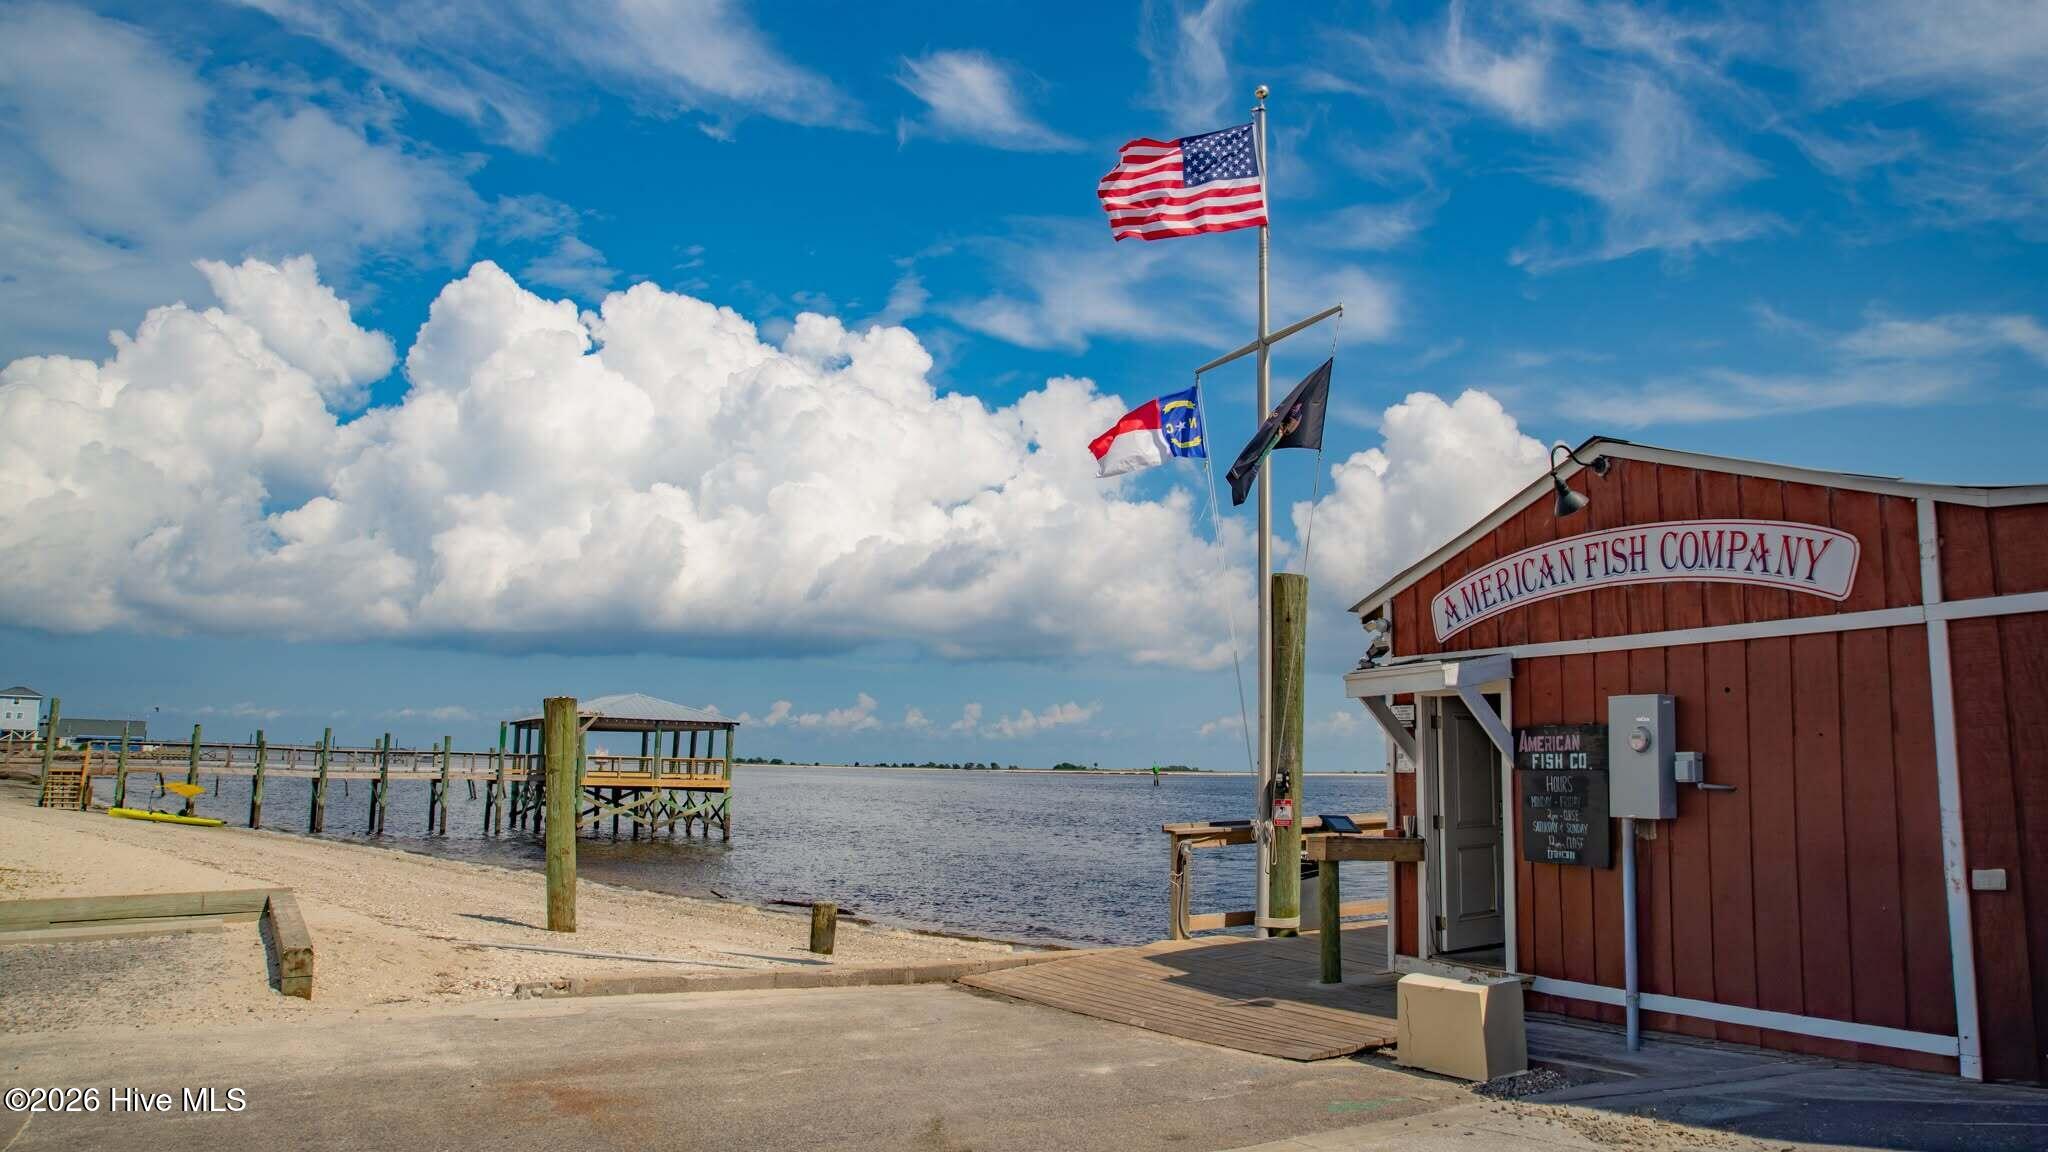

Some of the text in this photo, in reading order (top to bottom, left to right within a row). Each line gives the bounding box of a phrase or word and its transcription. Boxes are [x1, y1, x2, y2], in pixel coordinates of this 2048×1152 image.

[1443, 529, 1834, 629] AMERICAN FISH COMPANY
[1519, 730, 1581, 753] AMERICAN
[1531, 753, 1563, 770] FISH
